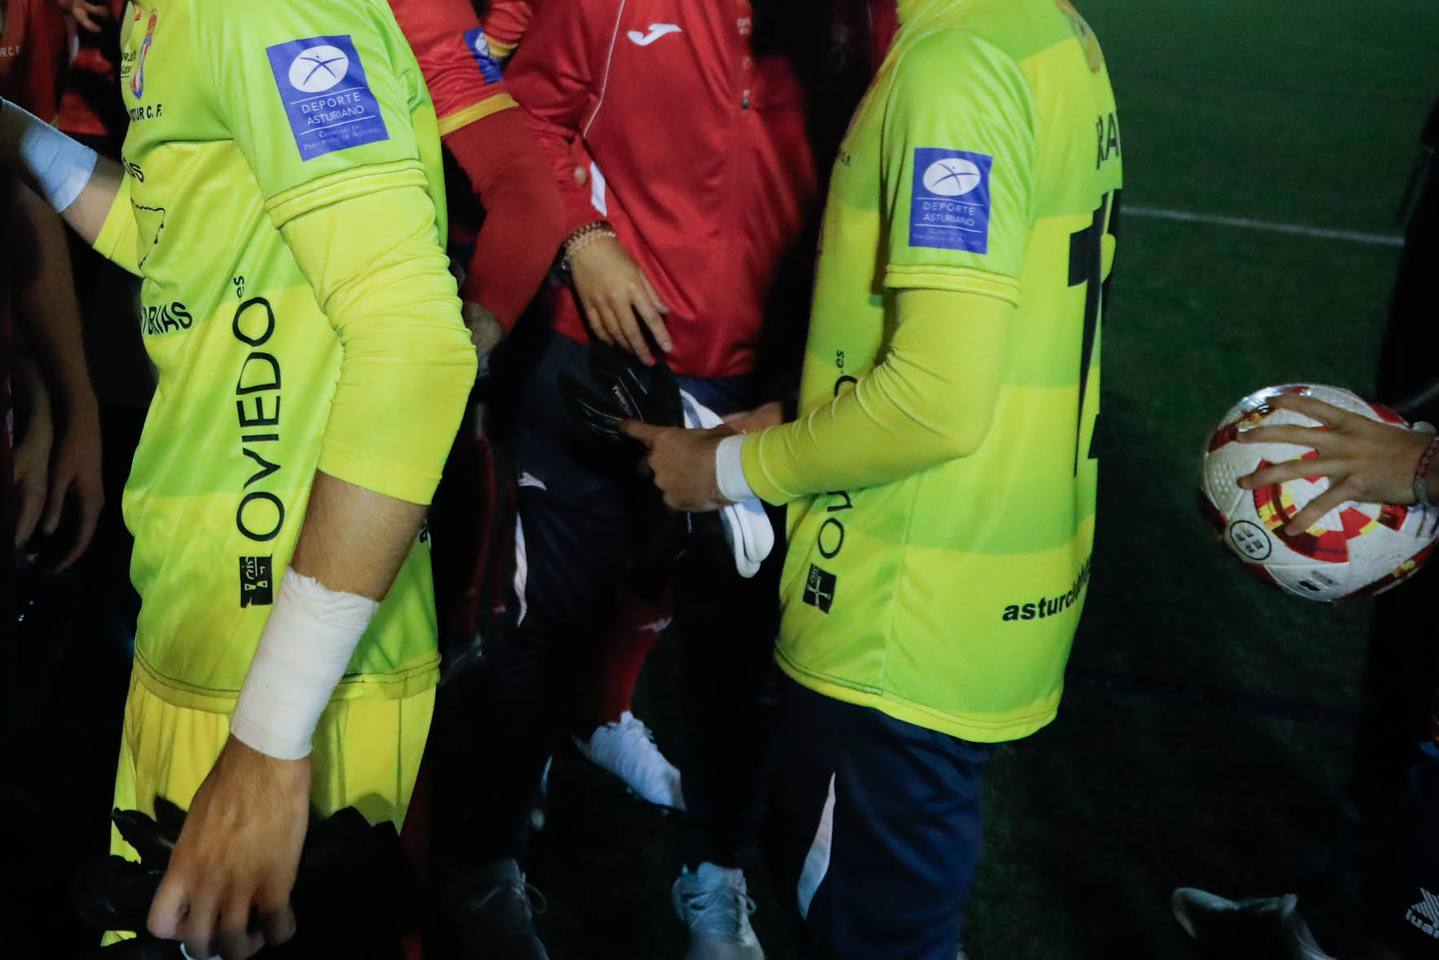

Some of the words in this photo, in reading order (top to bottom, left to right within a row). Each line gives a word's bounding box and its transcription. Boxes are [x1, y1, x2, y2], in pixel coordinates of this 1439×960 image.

[301, 92, 362, 114] DEPORTE
[307, 105, 365, 126] ASTURIANO
[923, 202, 976, 216] DEPORTE
[923, 214, 975, 227] ASTURIANO
[232, 296, 286, 543] OVIEDO
